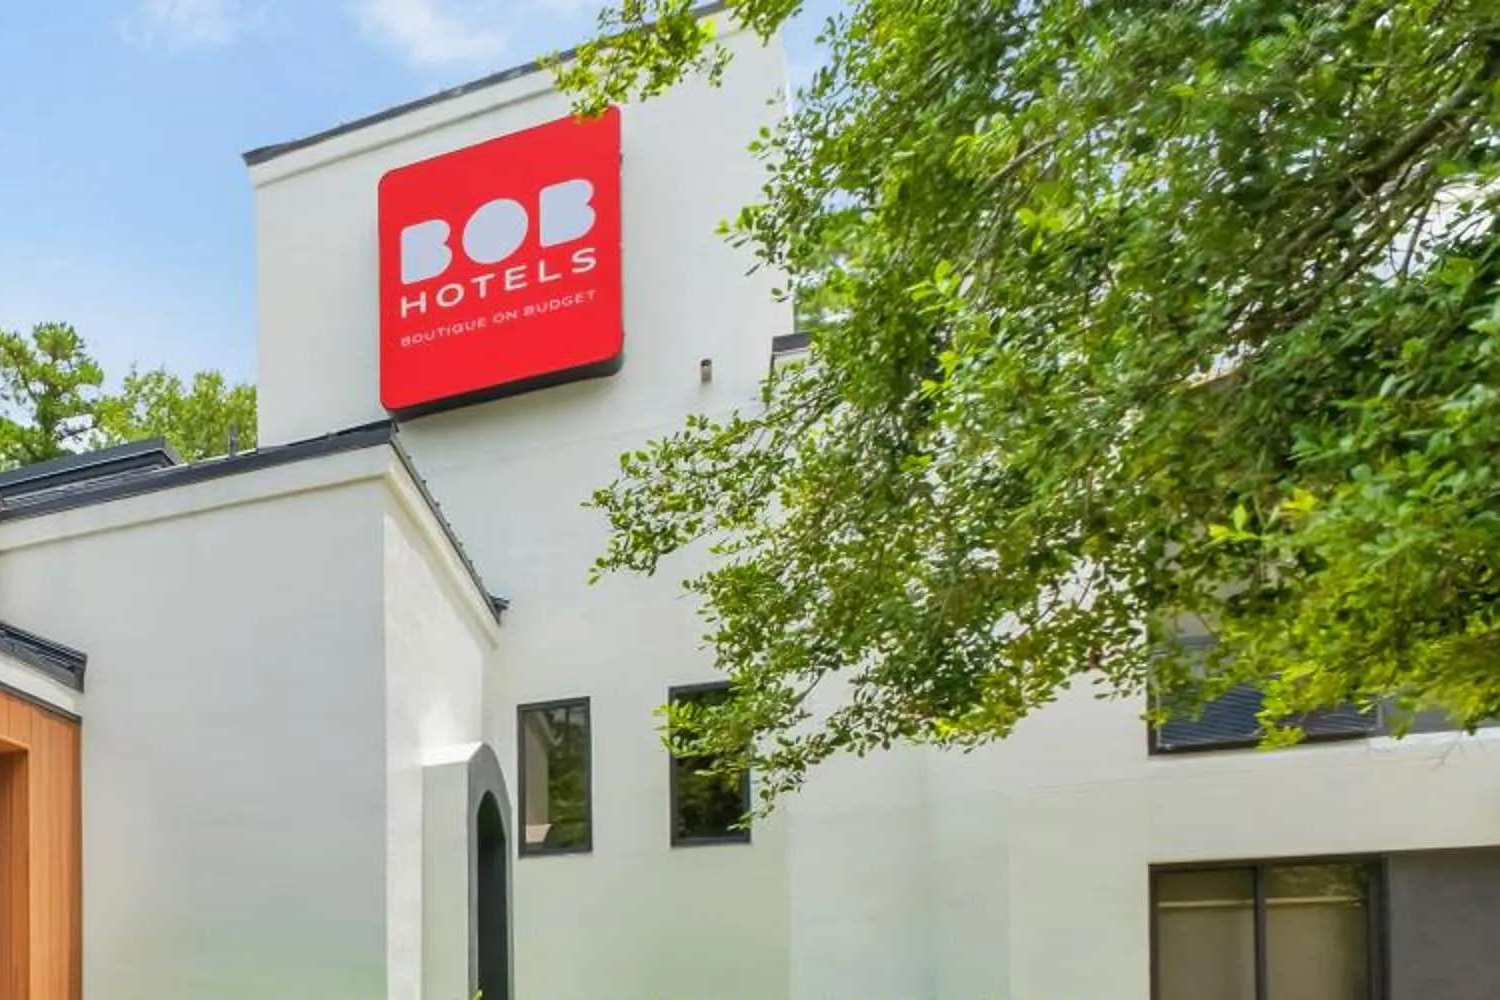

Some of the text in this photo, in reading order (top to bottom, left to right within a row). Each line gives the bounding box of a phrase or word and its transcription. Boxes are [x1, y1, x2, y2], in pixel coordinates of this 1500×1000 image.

[400, 179, 597, 285] BOB
[400, 247, 597, 319] HOTELS
[401, 290, 596, 347] BOUTIQUE ON BUDGET
